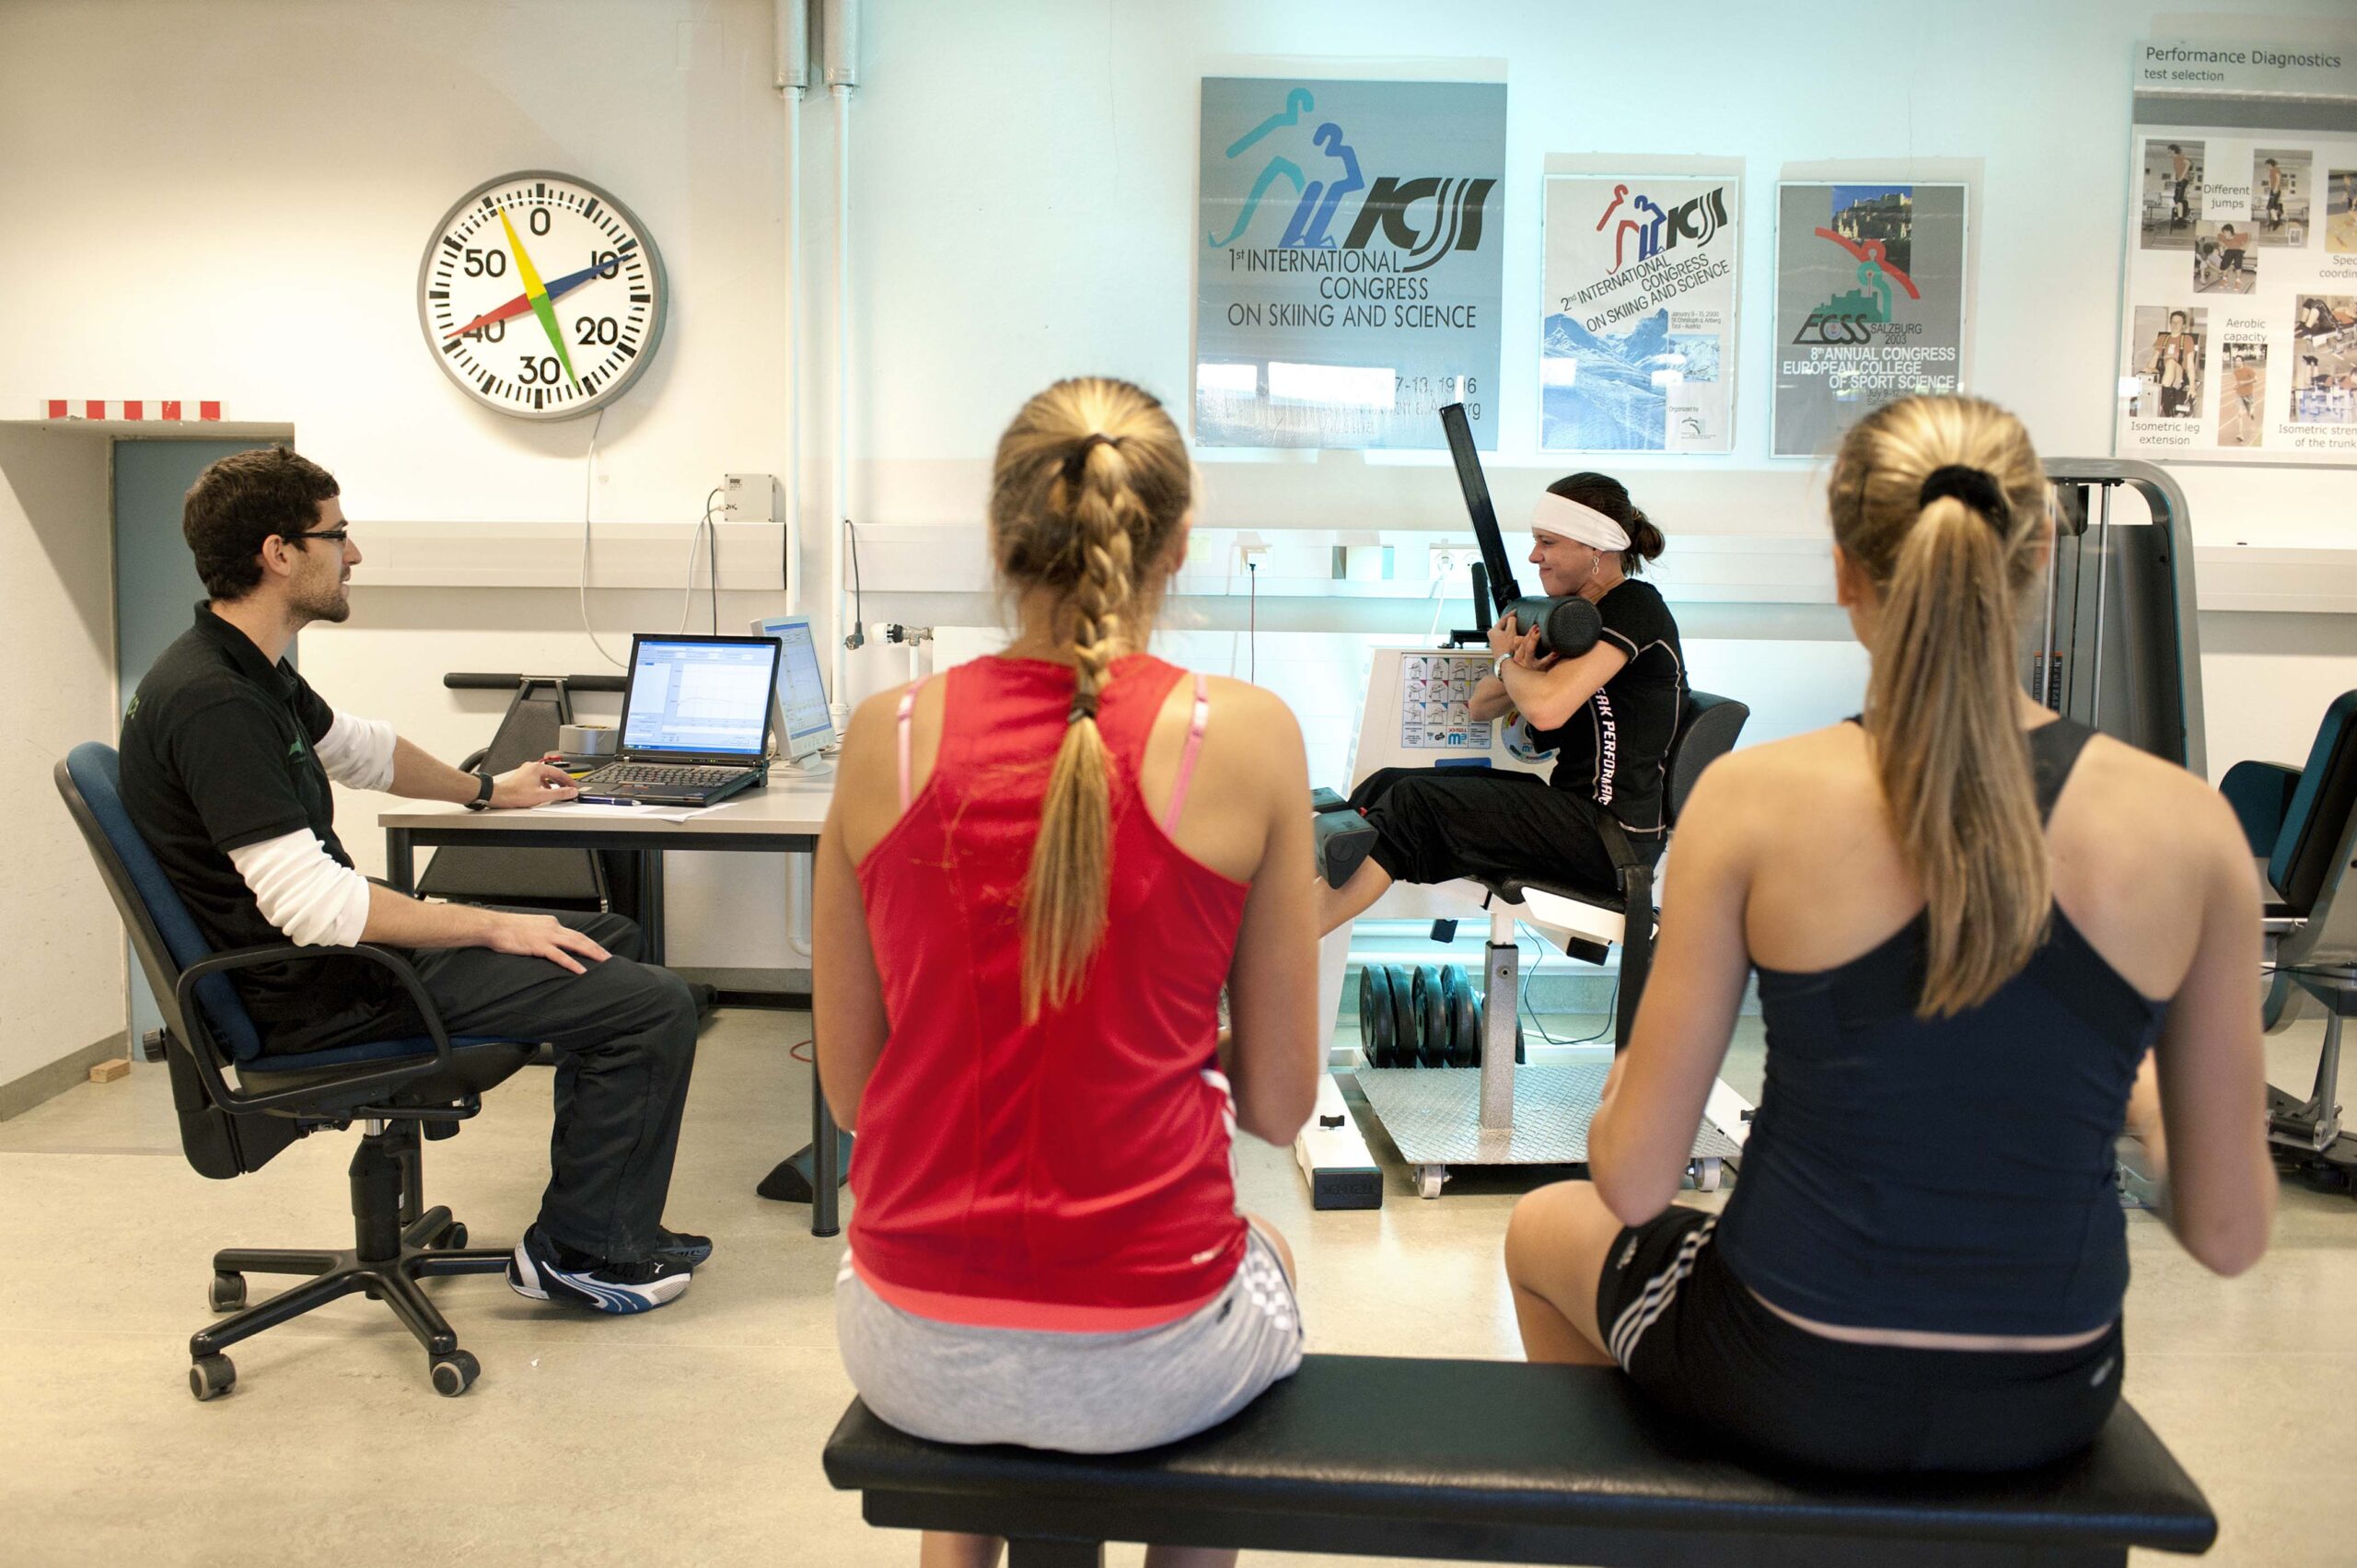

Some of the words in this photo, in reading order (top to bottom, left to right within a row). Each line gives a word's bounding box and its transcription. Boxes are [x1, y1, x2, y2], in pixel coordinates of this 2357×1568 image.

[2146, 47, 2246, 64] Performance
[2251, 51, 2341, 68] Diagnostics
[2144, 68, 2166, 79] test
[2171, 69, 2224, 81] selection
[2203, 184, 2250, 195] Different
[2211, 198, 2245, 209] jumps
[529, 207, 551, 236] 0
[464, 249, 506, 277] 50
[591, 250, 619, 280] 10
[1248, 250, 1400, 273] INTERNATIONAL
[1577, 255, 1672, 306] INTERNATIONAL
[1642, 253, 1710, 293] CONGRESS
[1320, 277, 1428, 300] CONGRESS
[1586, 314, 1607, 332] ON
[1607, 296, 1649, 324] SKIING
[1651, 284, 1677, 308] AND
[1678, 260, 1730, 293] SCIENCE
[1228, 304, 1261, 326] ON
[1269, 304, 1334, 328] SKIING
[1342, 305, 1387, 327] AND
[1394, 305, 1476, 329] SCIENCE
[2226, 319, 2266, 329] Aerobic
[575, 316, 618, 345] 20
[1870, 323, 1922, 335] SALZBURG
[1885, 334, 1907, 344] 2003
[2223, 331, 2268, 343] capacity
[1825, 347, 1879, 360] ANNUAL
[1882, 347, 1956, 360] CONGRESS
[517, 356, 560, 385] 30
[1783, 361, 1856, 375] EUROPEAN
[1859, 361, 1922, 375] COLLEGE
[1439, 377, 1477, 394] 196
[1829, 376, 1848, 389] OF
[1851, 376, 1894, 389] SPORT
[1898, 376, 1956, 389] SCIENCE
[2131, 422, 2181, 432] Isometric
[2185, 423, 2200, 434] leg
[2279, 424, 2328, 435] Isometric
[2139, 436, 2190, 446] extension
[2294, 437, 2305, 447] of
[2308, 438, 2326, 447] the
[2328, 439, 2357, 448] trunk
[1596, 687, 1613, 717] EAK
